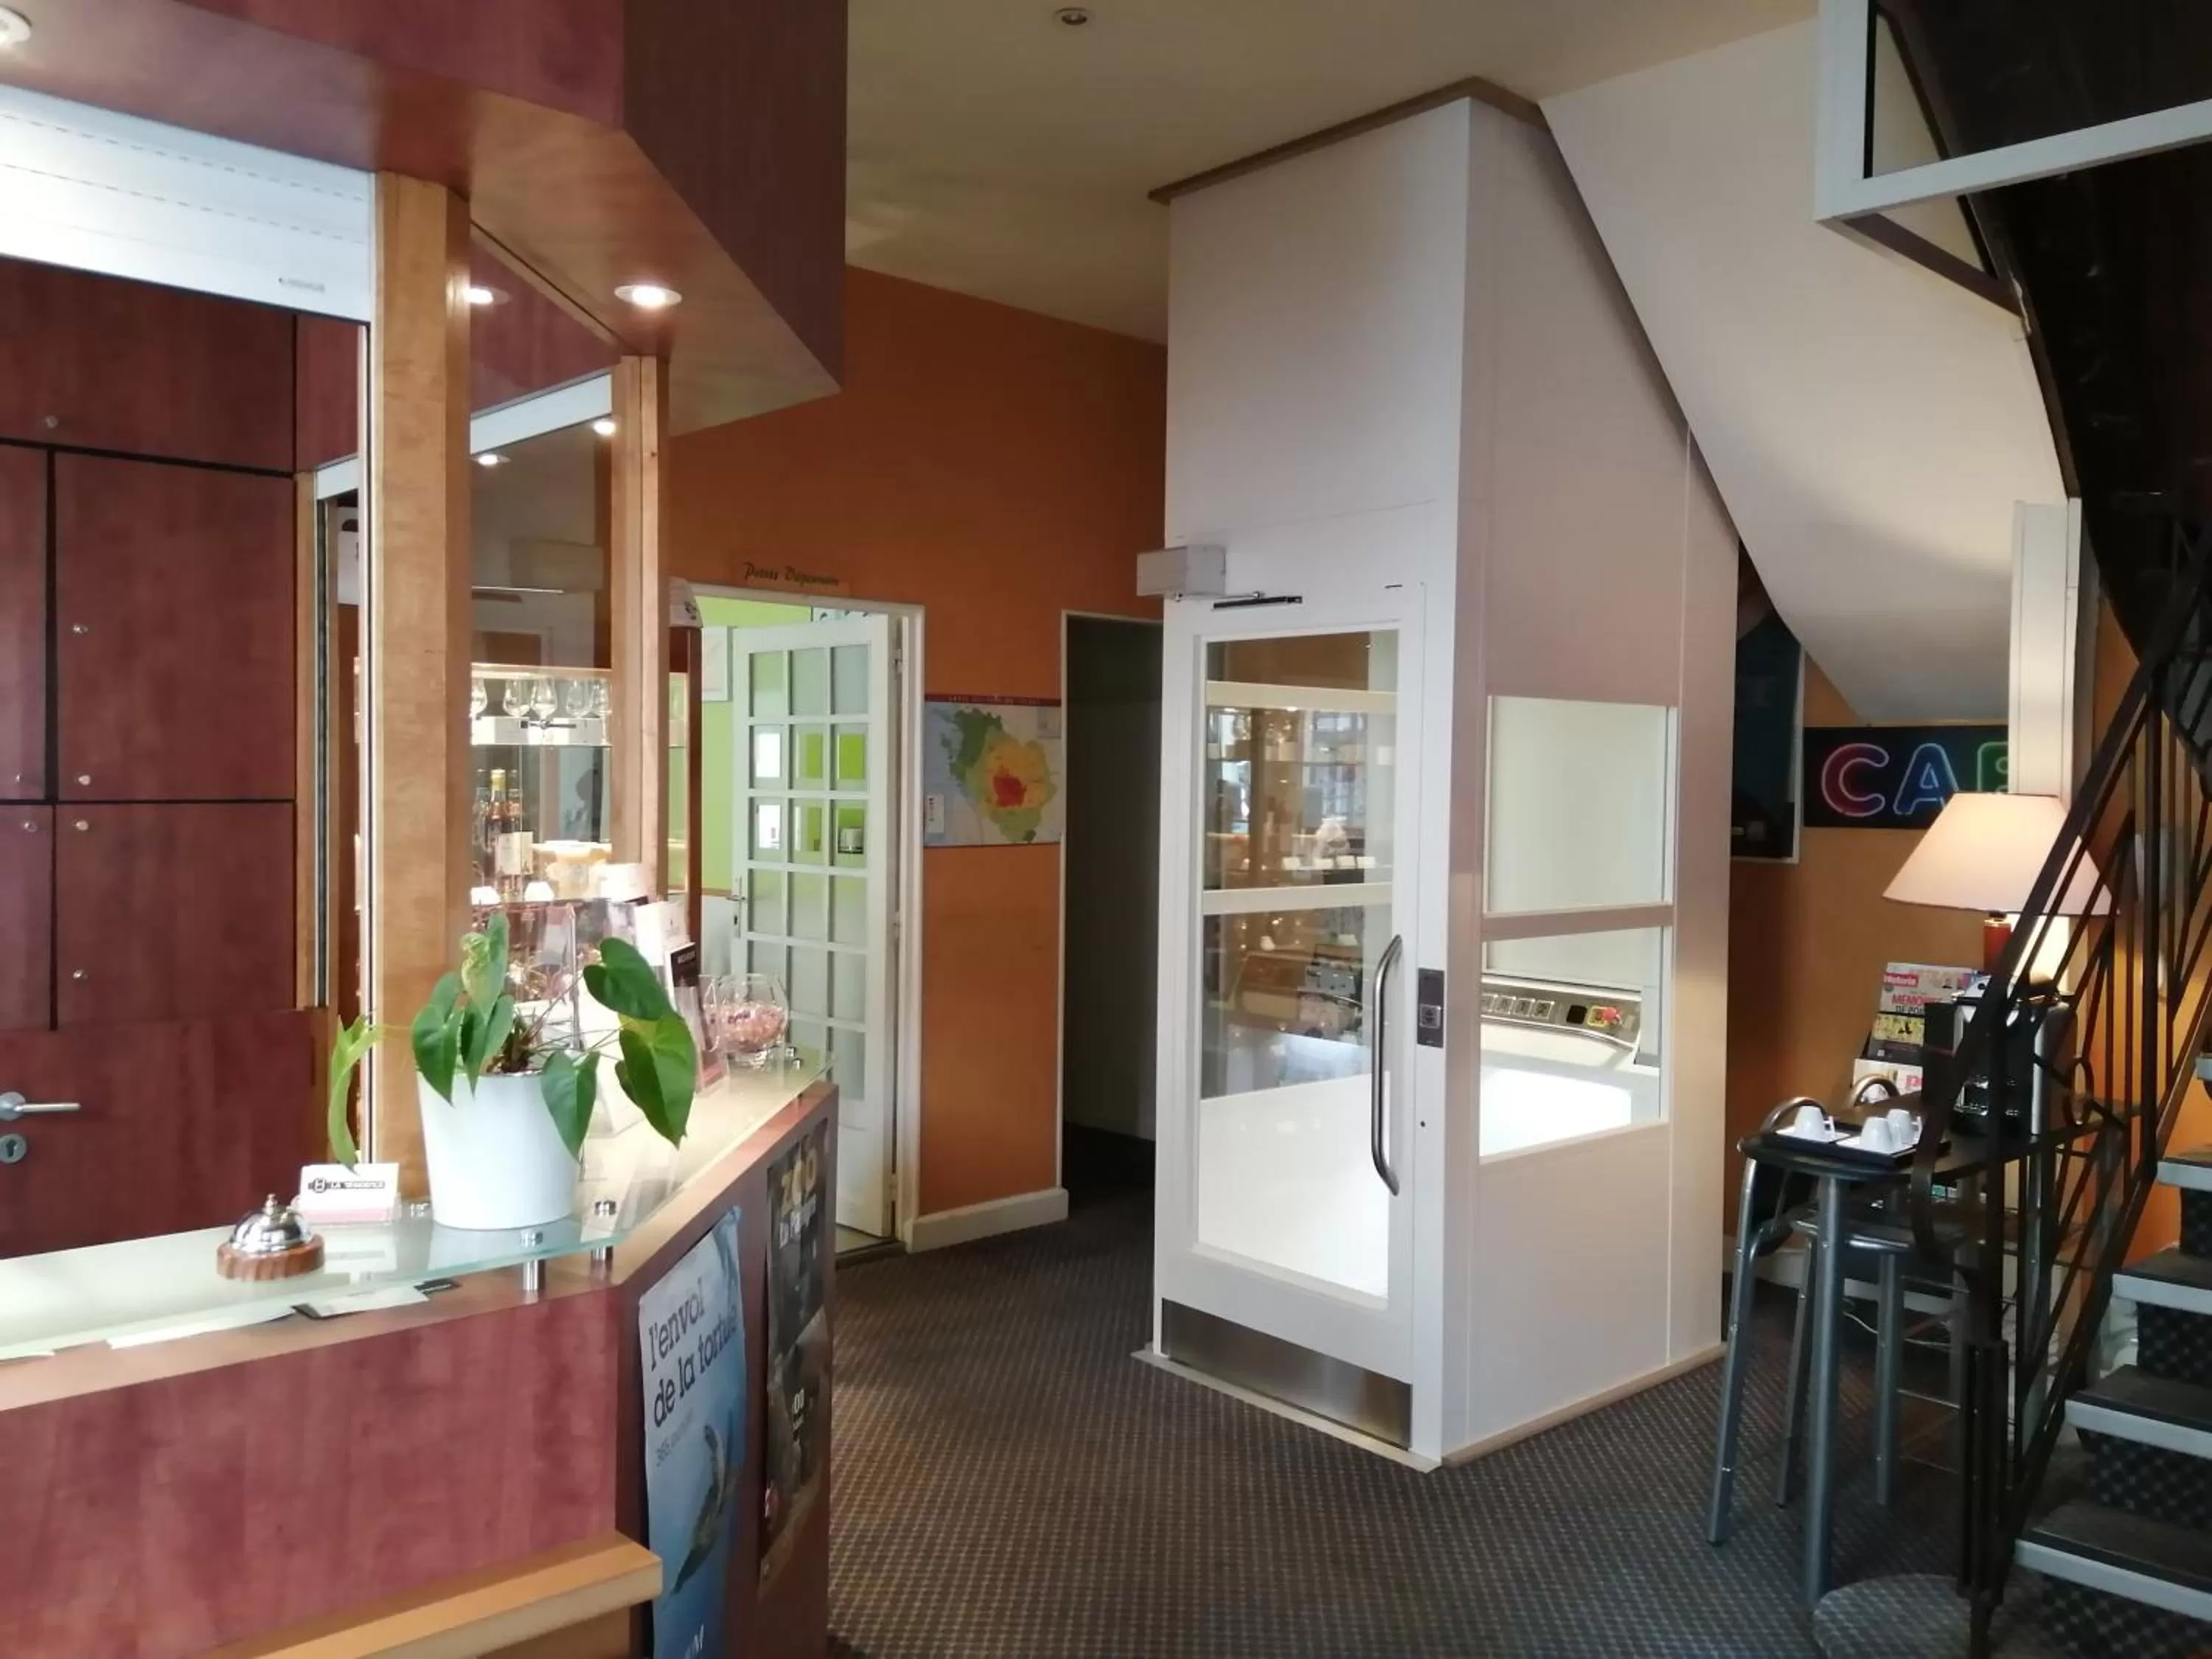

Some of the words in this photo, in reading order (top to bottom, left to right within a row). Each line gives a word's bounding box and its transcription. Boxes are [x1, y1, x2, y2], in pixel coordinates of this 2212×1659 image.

[648, 1276, 706, 1372] l'envol
[653, 1377, 676, 1428] de
[678, 1354, 696, 1399] la
[698, 1304, 738, 1374] tortue
